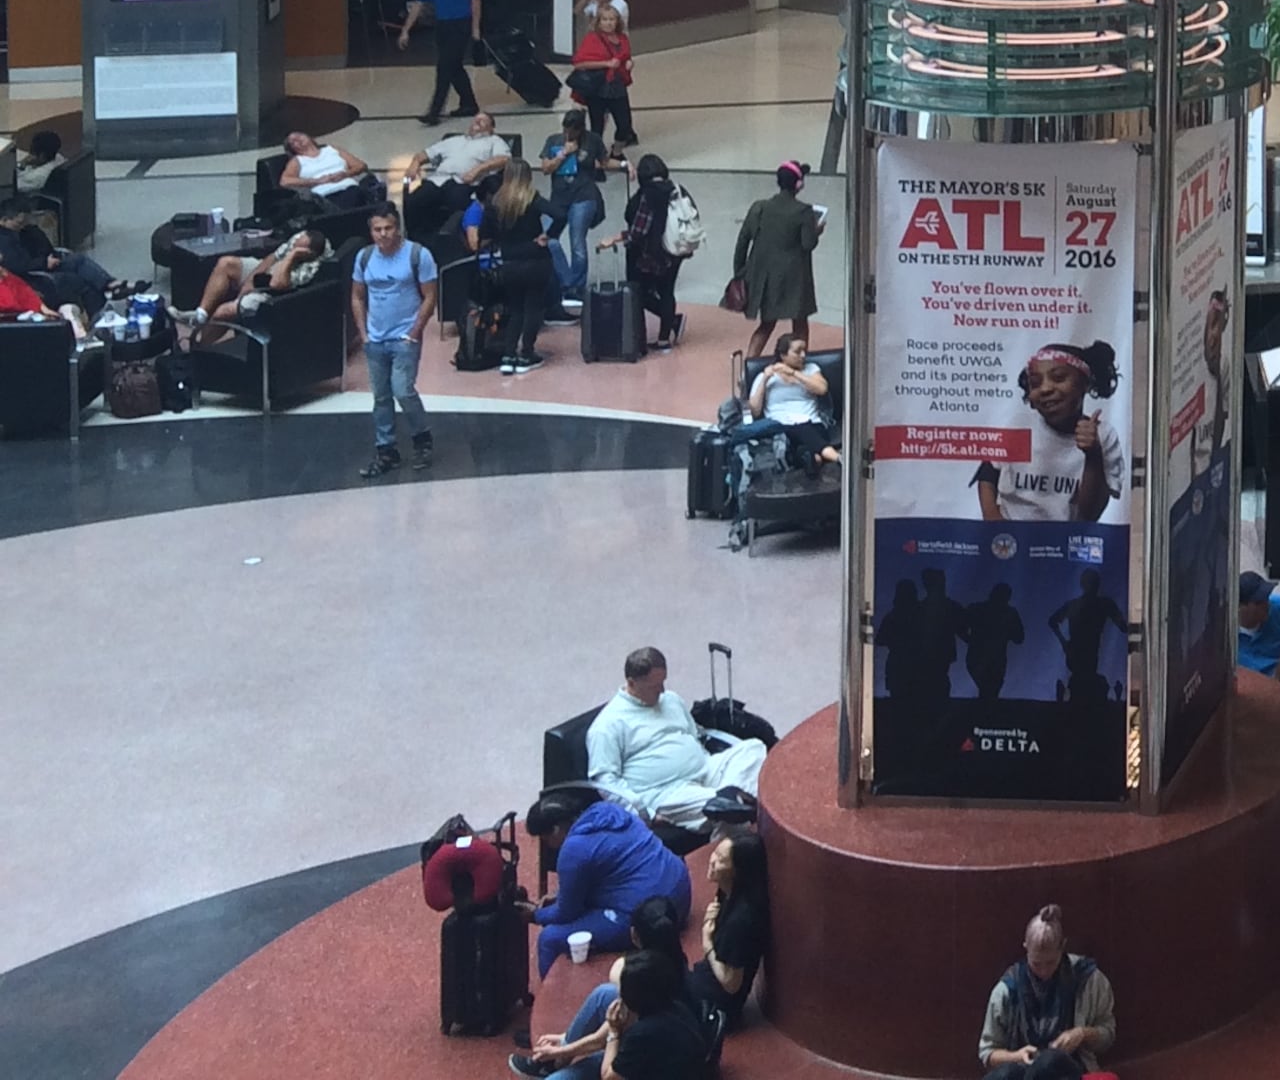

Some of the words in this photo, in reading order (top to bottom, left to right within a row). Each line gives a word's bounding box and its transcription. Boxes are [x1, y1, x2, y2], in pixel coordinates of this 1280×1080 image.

[898, 179, 935, 194] THE
[940, 180, 1020, 196] MAYOR'S
[1023, 182, 1045, 197] 5K
[1066, 182, 1117, 196] Saturday
[1066, 194, 1117, 209] August
[1175, 168, 1214, 246] ATL
[899, 198, 1045, 252] ATL
[1065, 210, 1117, 246] 27
[898, 253, 918, 264] ON
[921, 253, 950, 265] THE
[952, 254, 980, 266] 5TH
[983, 255, 1045, 267] RUNWAY
[1065, 249, 1116, 269] 2016
[932, 281, 981, 296] You've
[984, 282, 1028, 297] flown
[1031, 286, 1065, 297] over
[1067, 284, 1083, 298] it.
[921, 297, 971, 311] You've
[974, 297, 1026, 312] driven
[1028, 299, 1074, 314] under
[1077, 300, 1093, 314] it.
[953, 314, 988, 327] Now
[991, 317, 1020, 328] run
[1022, 318, 1041, 329] on
[1042, 316, 1060, 330] it!
[906, 339, 938, 351] Race
[942, 340, 1004, 355] proceeds
[907, 355, 956, 367] benefit
[959, 356, 1003, 367] UWGA
[901, 370, 926, 381] and
[930, 370, 947, 381] its
[951, 372, 1008, 386] partners
[895, 385, 970, 400] throughout
[974, 387, 1014, 399] metro
[929, 401, 980, 413] Atlanta
[907, 427, 967, 442] Register
[969, 430, 1003, 442] now:
[900, 442, 1008, 458] http://5k.atl.com
[1015, 472, 1049, 492] LIVE
[981, 738, 1040, 752] DELTA
